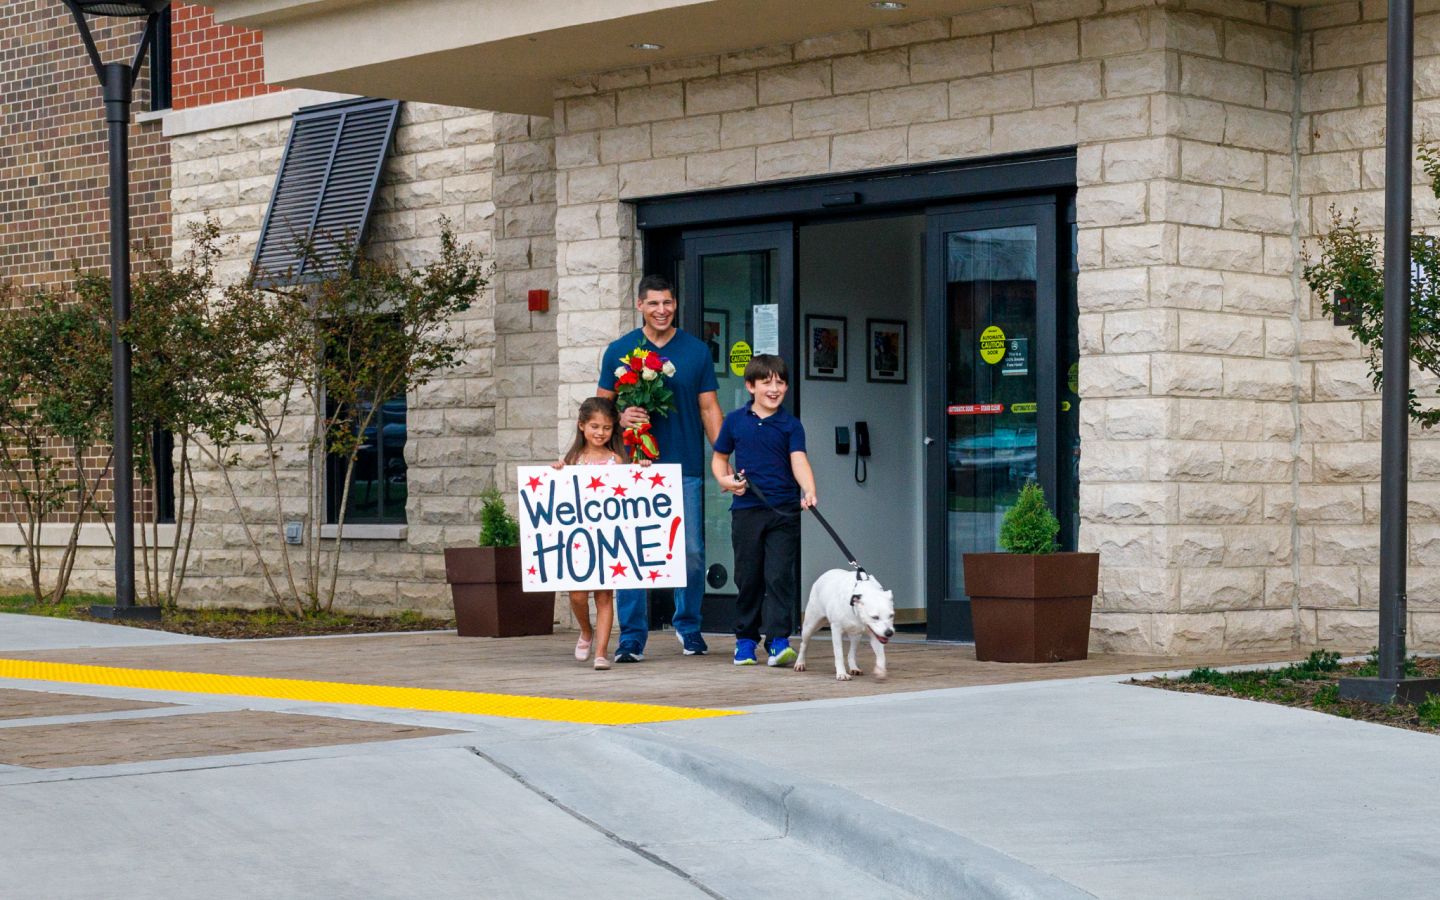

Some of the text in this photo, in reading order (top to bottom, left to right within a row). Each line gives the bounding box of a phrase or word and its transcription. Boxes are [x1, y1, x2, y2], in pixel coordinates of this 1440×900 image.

[981, 340, 1005, 349] CAUTION
[520, 474, 672, 529] Welcome
[532, 516, 682, 585] HOME!
